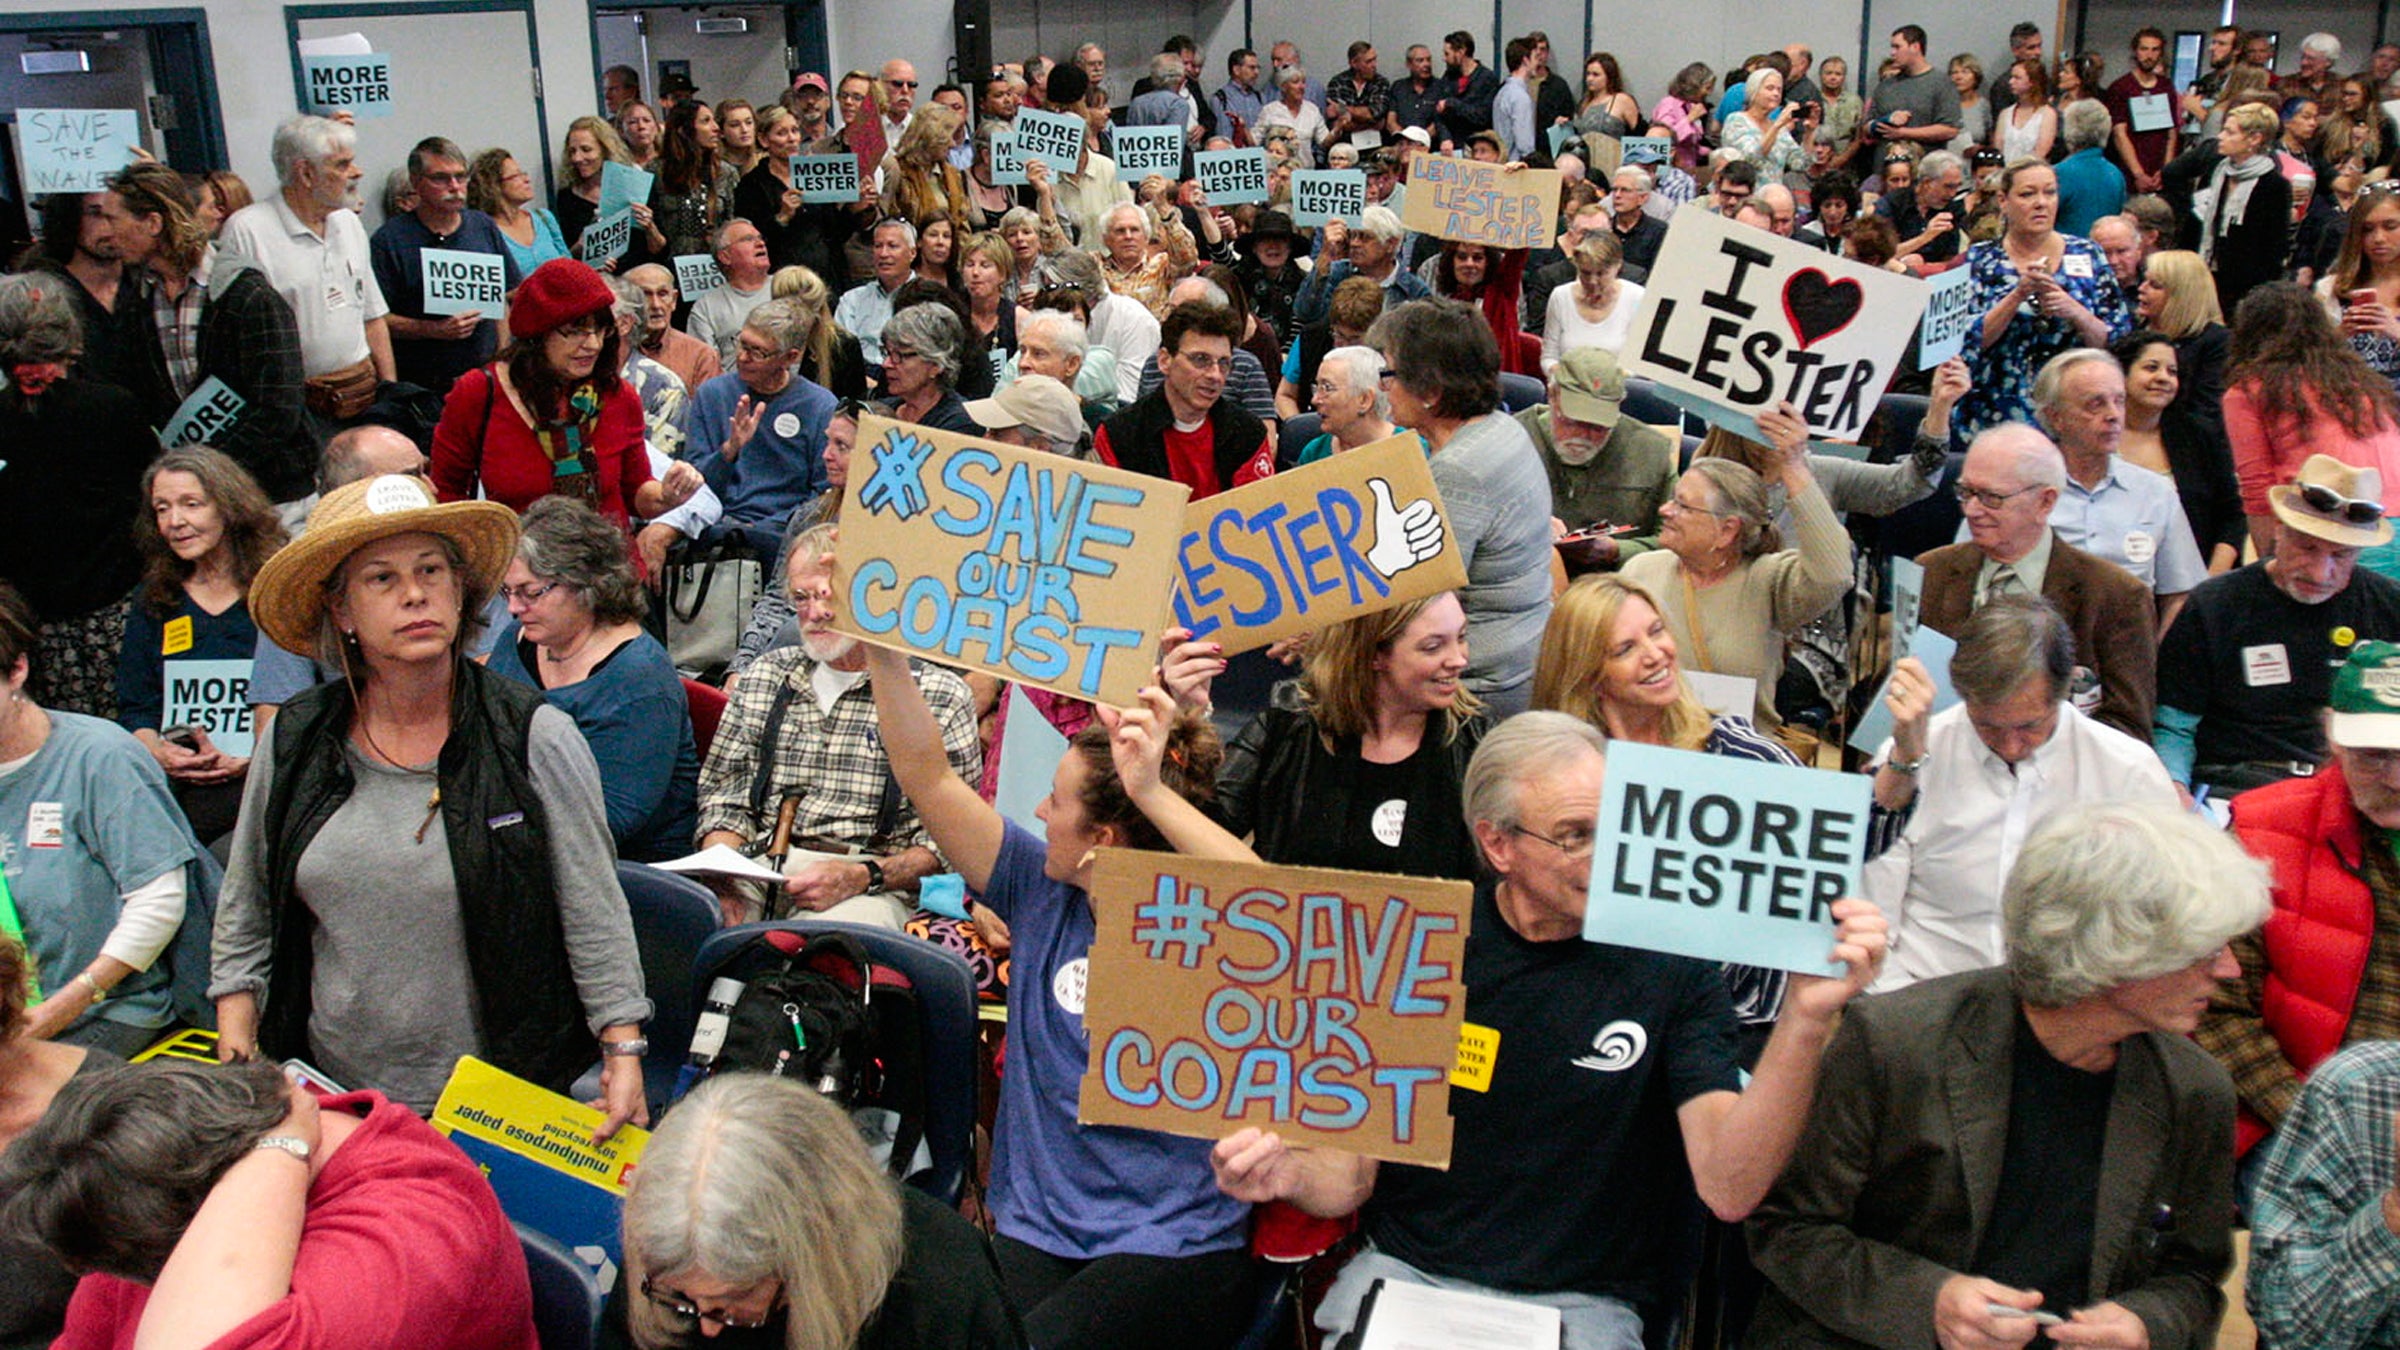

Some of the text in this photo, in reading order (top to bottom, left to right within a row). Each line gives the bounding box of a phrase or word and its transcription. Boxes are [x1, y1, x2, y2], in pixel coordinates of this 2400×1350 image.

[311, 65, 388, 85] MORE
[313, 85, 390, 105] LESTER
[31, 112, 111, 143] SAVE
[1020, 117, 1080, 144] MORE
[52, 146, 95, 161] THE
[1017, 134, 1078, 160] LESTER
[1118, 136, 1179, 152] MORE
[794, 161, 855, 176] MORE
[1119, 152, 1180, 168] LESTER
[1201, 157, 1263, 177] MORE
[1414, 156, 1495, 190] LEAVE
[795, 176, 857, 191] LESTER
[1202, 174, 1265, 194] LESTER
[1300, 180, 1362, 199] MORE
[1300, 197, 1361, 215] LESTER
[1433, 184, 1542, 224] LESTER
[586, 216, 629, 247] MORE
[1445, 212, 1544, 246] ALONE
[585, 231, 628, 261] LESTER
[429, 261, 501, 283] MORE
[683, 275, 725, 293] ORE
[1702, 237, 1775, 320] I
[431, 281, 502, 303] LESTER
[1930, 281, 1968, 318] MORE
[1641, 298, 1875, 433] LESTER
[171, 388, 240, 448] ORE
[858, 426, 1146, 579] #SAVE
[1172, 486, 1391, 642] LESTER
[956, 549, 1082, 624] OUR
[850, 557, 1144, 698] COAST
[172, 678, 250, 705] MOR
[170, 707, 253, 733] LESTE
[1620, 782, 1855, 865] MORE
[1612, 841, 1848, 926] LESTER
[1132, 873, 1459, 1017] #SAVE
[1203, 983, 1373, 1070] OUR
[1102, 1026, 1445, 1145] COAST
[453, 1104, 504, 1131] paper
[505, 1124, 610, 1175] multipurpose
[542, 1123, 593, 1148] recycled
